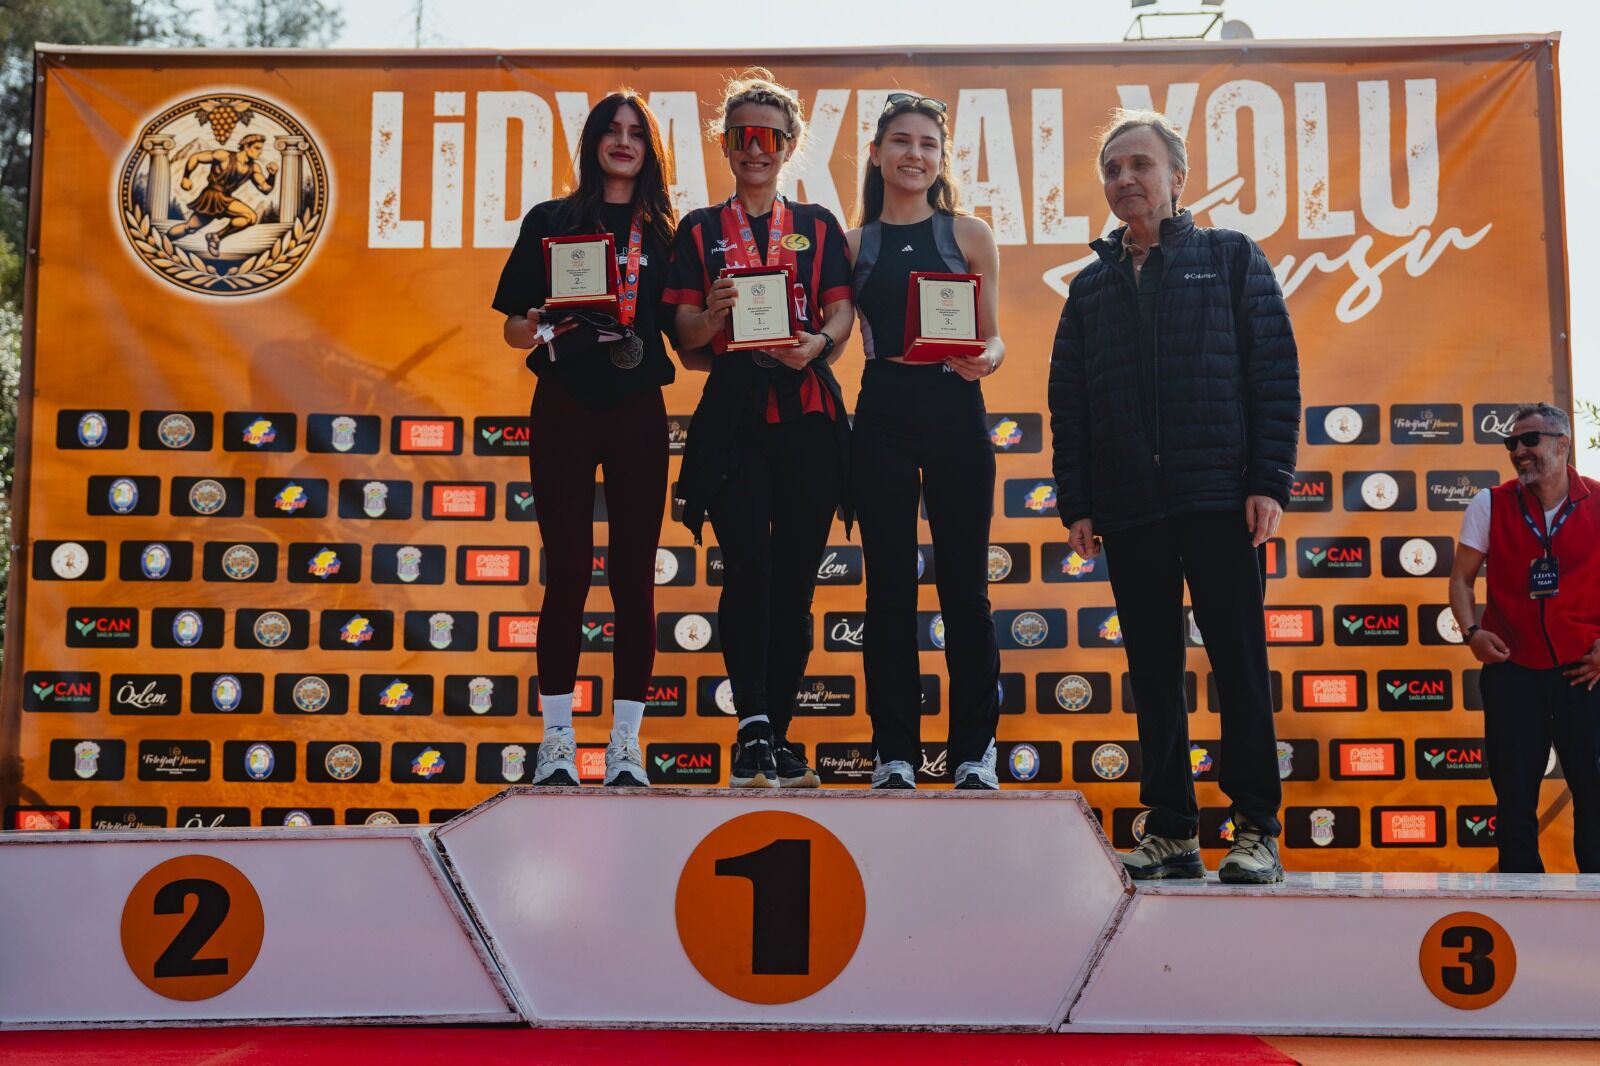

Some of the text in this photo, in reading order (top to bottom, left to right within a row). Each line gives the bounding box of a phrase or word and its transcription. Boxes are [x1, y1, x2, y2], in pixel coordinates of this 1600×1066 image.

[788, 88, 1090, 245] KAL
[1481, 410, 1516, 438] Özl
[817, 552, 848, 579] lem
[1328, 547, 1362, 561] CAN
[97, 618, 130, 631] CAN
[831, 618, 864, 645] Özl
[1364, 616, 1399, 629] CAN
[55, 682, 91, 695] CAN
[117, 681, 167, 708] Özlem
[1408, 681, 1443, 694] CAN
[676, 754, 711, 768] CAN
[919, 750, 946, 777] zle
[1446, 749, 1481, 762] CAN
[716, 840, 810, 975] 1
[153, 879, 230, 977] 2
[1442, 927, 1494, 994] 3
